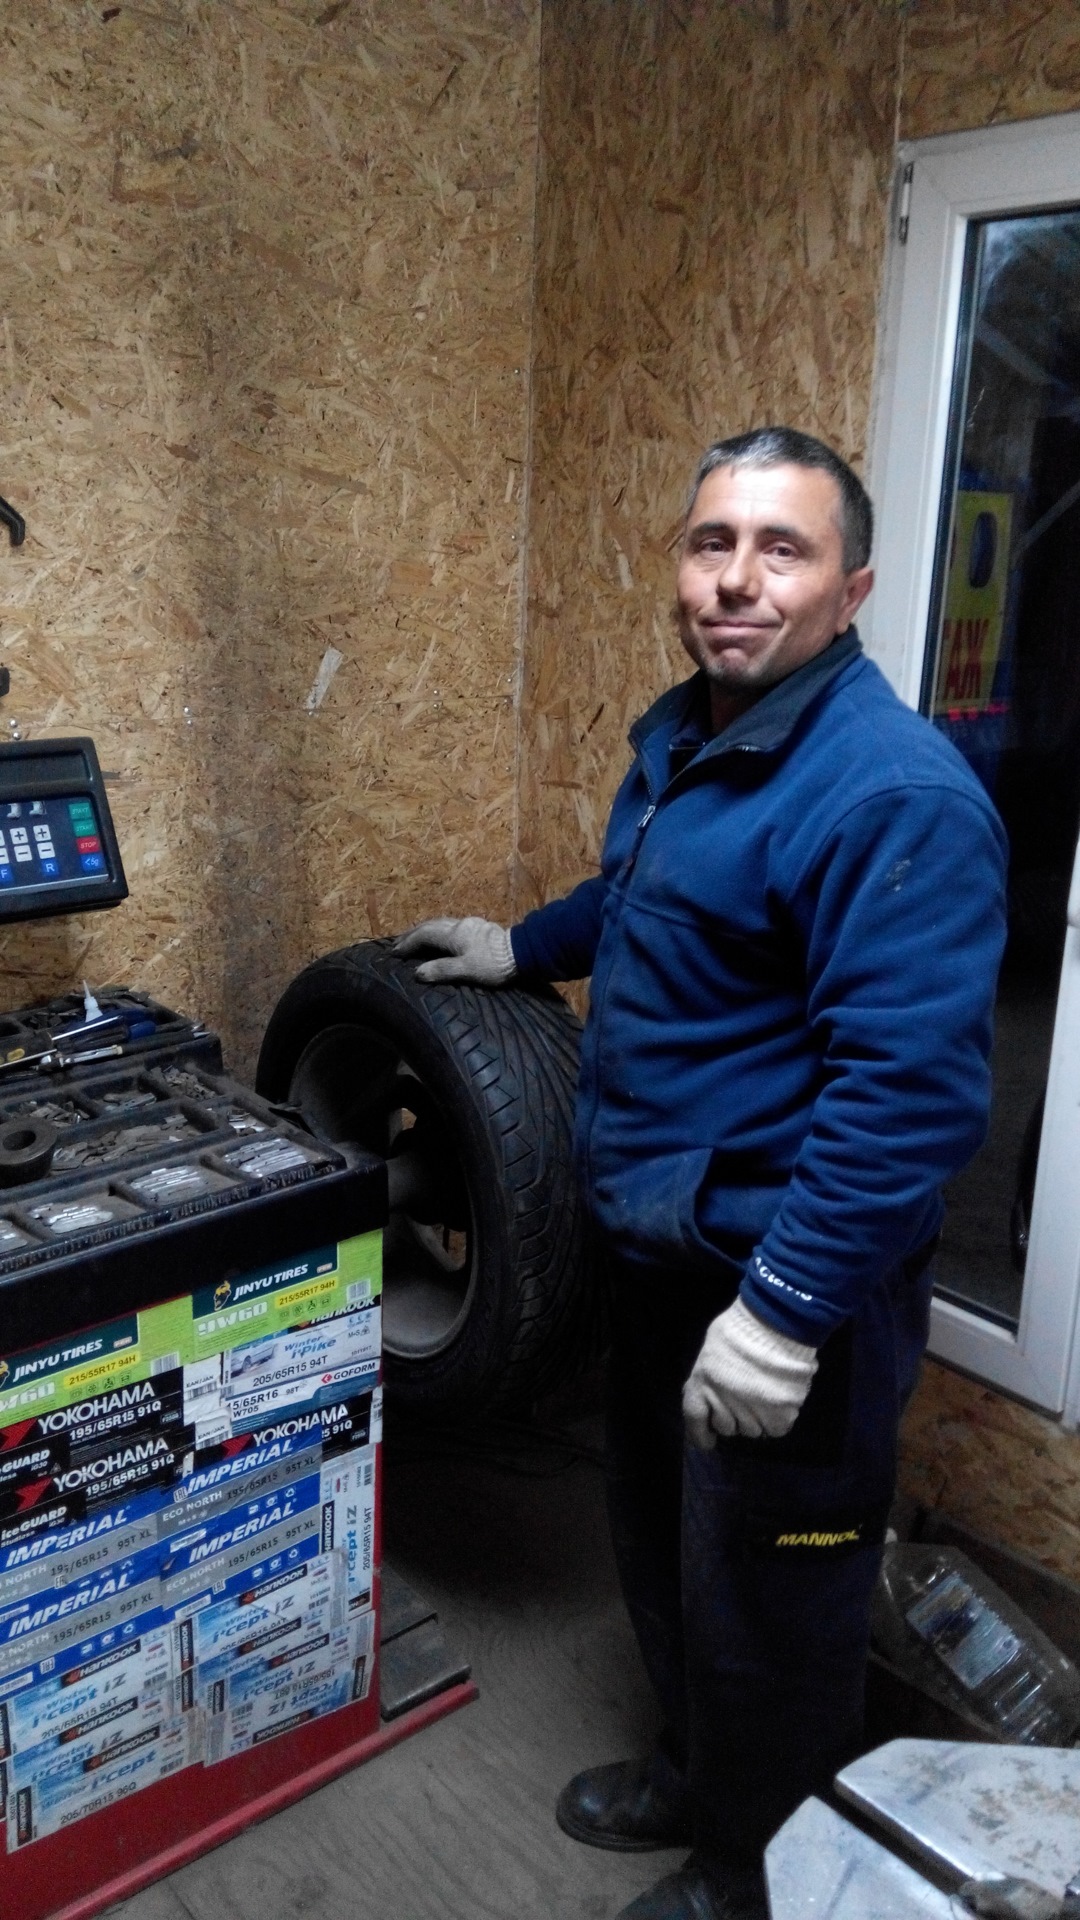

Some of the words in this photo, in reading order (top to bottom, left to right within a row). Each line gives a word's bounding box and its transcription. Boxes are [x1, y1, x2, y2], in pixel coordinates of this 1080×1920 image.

[80, 841, 97, 849] STOP
[0, 869, 8, 879] F
[45, 863, 55, 873] R
[233, 1277, 273, 1301] JINYU
[274, 1263, 309, 1284] TIRES
[279, 1284, 318, 1306] 215/55R17
[319, 1279, 336, 1293] 94H
[12, 1354, 61, 1383] JINYU
[61, 1338, 104, 1362] TIRES
[284, 1334, 323, 1352] Winter
[68, 1362, 117, 1386] 215/55R17
[117, 1353, 137, 1368] 94H
[252, 1361, 308, 1388] 205/65R15
[309, 1354, 329, 1369] 94T
[333, 1362, 376, 1381] GOFORM
[38, 1381, 155, 1435] YOKOHAMA
[69, 1409, 136, 1441] 195/65R15
[137, 1400, 162, 1418] 91Q
[232, 1405, 260, 1419] W705
[252, 1403, 349, 1448] YOKOHAMA
[332, 1419, 353, 1436] 91Q
[53, 1437, 169, 1493] YOKOHAMA
[86, 1463, 149, 1497] 195/65R15
[151, 1452, 175, 1471] 91Q
[187, 1440, 294, 1495] IMPERIAL
[162, 1506, 184, 1522] ECO
[186, 1490, 222, 1511] NORTH
[285, 1461, 303, 1475] 95T
[1, 1505, 68, 1541] iceGUARD
[5, 1509, 128, 1569] IMPERIAL
[189, 1501, 294, 1565] IMPERIAL
[775, 1530, 860, 1546] MANNOL
[5, 1565, 48, 1586] NORTH
[117, 1534, 136, 1550] 95T
[166, 1577, 187, 1593] ECO
[227, 1537, 279, 1569] 195/65R15
[285, 1525, 303, 1540] 95T
[304, 1519, 316, 1530] XL
[8, 1573, 131, 1638] IMPERIAL
[53, 1612, 111, 1644] 195/65R15
[119, 1598, 138, 1614] 95T
[140, 1592, 154, 1604] XL
